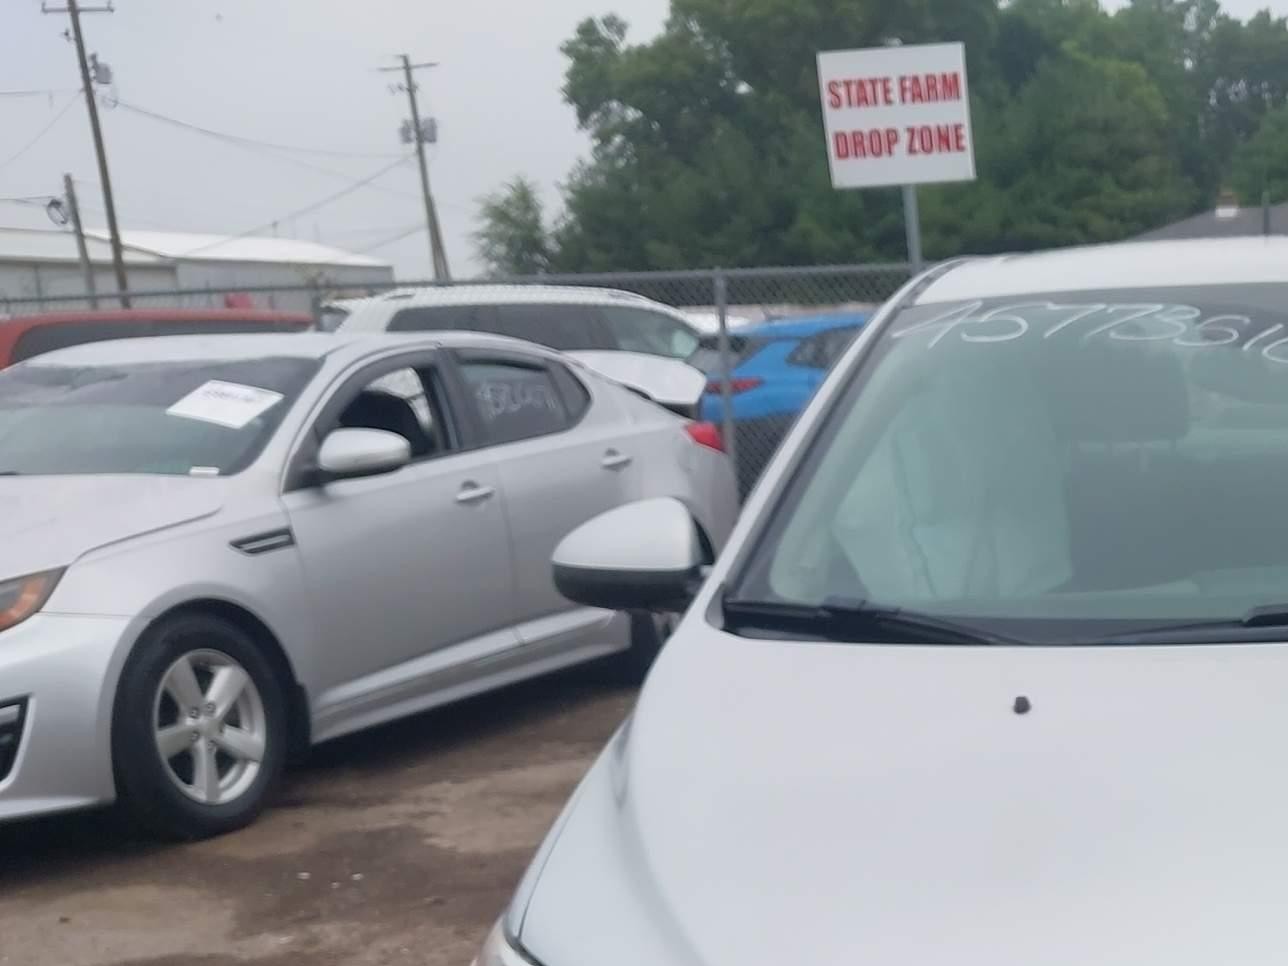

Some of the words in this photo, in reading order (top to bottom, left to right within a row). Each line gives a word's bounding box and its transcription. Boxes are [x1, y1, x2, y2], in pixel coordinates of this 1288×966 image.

[828, 76, 893, 109] STATE
[899, 71, 961, 105] FARM
[834, 127, 898, 160] DROP
[906, 122, 966, 155] ZONE
